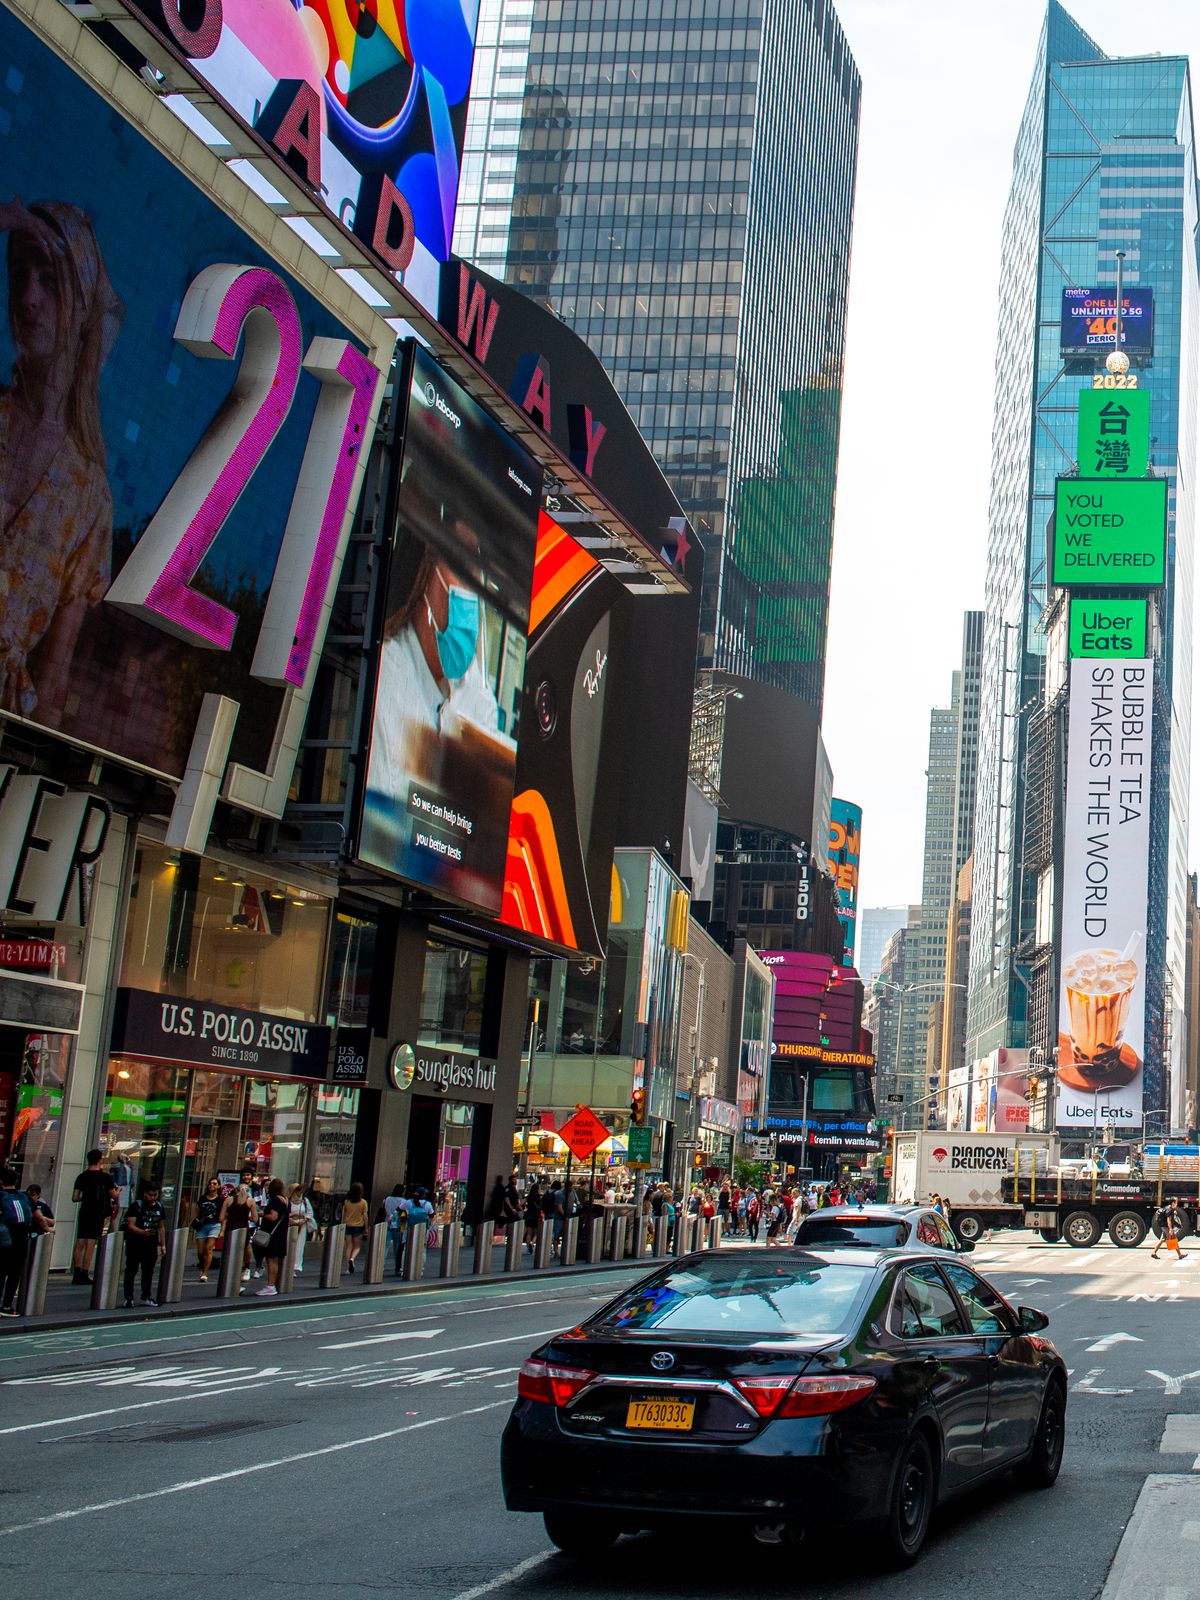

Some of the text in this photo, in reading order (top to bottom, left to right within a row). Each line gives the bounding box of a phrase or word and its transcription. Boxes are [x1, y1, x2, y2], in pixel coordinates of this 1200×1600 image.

[1084, 299, 1130, 307] ONE LIE
[1129, 307, 1142, 315] 5G
[1093, 374, 1137, 389] 2022
[436, 394, 461, 429] labcorp
[1095, 401, 1131, 473] 台灣
[173, 263, 380, 690] 21
[1066, 495, 1103, 508] YOU
[1066, 514, 1124, 527] VOTED
[1065, 533, 1092, 546] WE
[1064, 553, 1155, 566] DELIVERED
[1083, 613, 1133, 630] Uber
[1082, 633, 1133, 650] Eats
[1119, 668, 1145, 825] BUBBLE TEA
[1084, 667, 1114, 938] SHAKES THE WORLD
[412, 793, 472, 835] So we can help bring
[416, 832, 462, 860] you better tests
[796, 865, 809, 920] 1500
[160, 1003, 310, 1055] U.S. POLO ASSN.
[211, 1045, 259, 1063] SINCE 1890
[338, 1047, 356, 1055] U.S.
[337, 1055, 364, 1064] POLO
[336, 1064, 365, 1074] ASSN.
[417, 1056, 497, 1093] sunglass hut
[1006, 1109, 1029, 1117] PIG
[1101, 1105, 1133, 1119] Eats
[824, 1123, 839, 1131] per
[840, 1122, 866, 1131] official
[952, 1146, 1008, 1158] DIAMON
[952, 1158, 1007, 1169] DELIVERS
[1102, 1184, 1140, 1193] Commodore
[570, 1413, 605, 1422] CAMRY
[634, 1403, 688, 1422] T763033C
